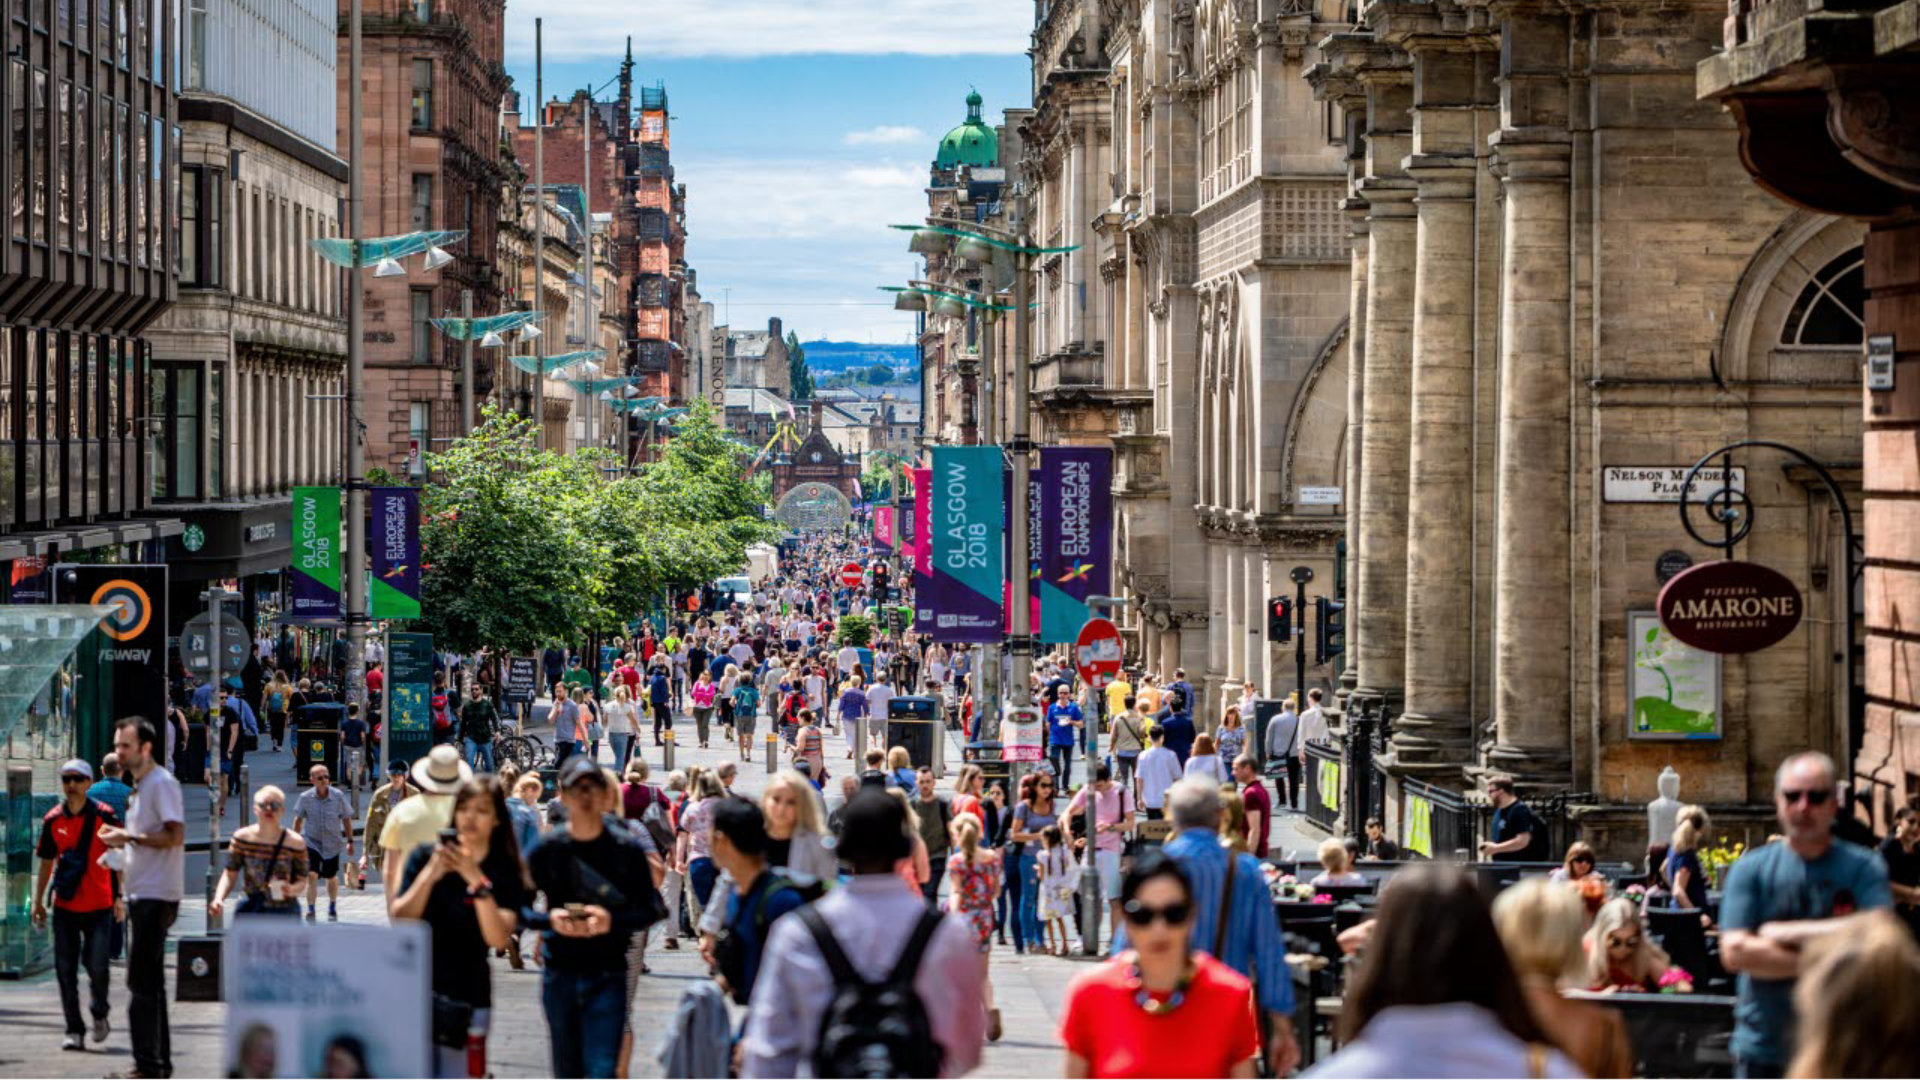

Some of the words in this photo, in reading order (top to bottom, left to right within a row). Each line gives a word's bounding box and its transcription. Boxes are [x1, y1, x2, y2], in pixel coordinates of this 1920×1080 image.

[712, 335, 724, 352] ST
[1610, 469, 1663, 481] NELSON
[1670, 469, 1739, 481] MNDEA
[385, 496, 397, 560] EUROPEAN
[397, 496, 406, 560] CHAMPIONSHIPS
[947, 462, 967, 569] GLASGOW
[1061, 461, 1078, 556] EUROPEAN
[1078, 461, 1090, 556] CHAMPIONSHIPS
[302, 496, 316, 569] GLASGOW
[317, 537, 330, 569] 2018
[968, 523, 987, 569] 2018
[1669, 597, 1795, 619] AMARONE
[1704, 587, 1758, 596] PIZZERIA
[1696, 620, 1768, 630] RISTORANTE
